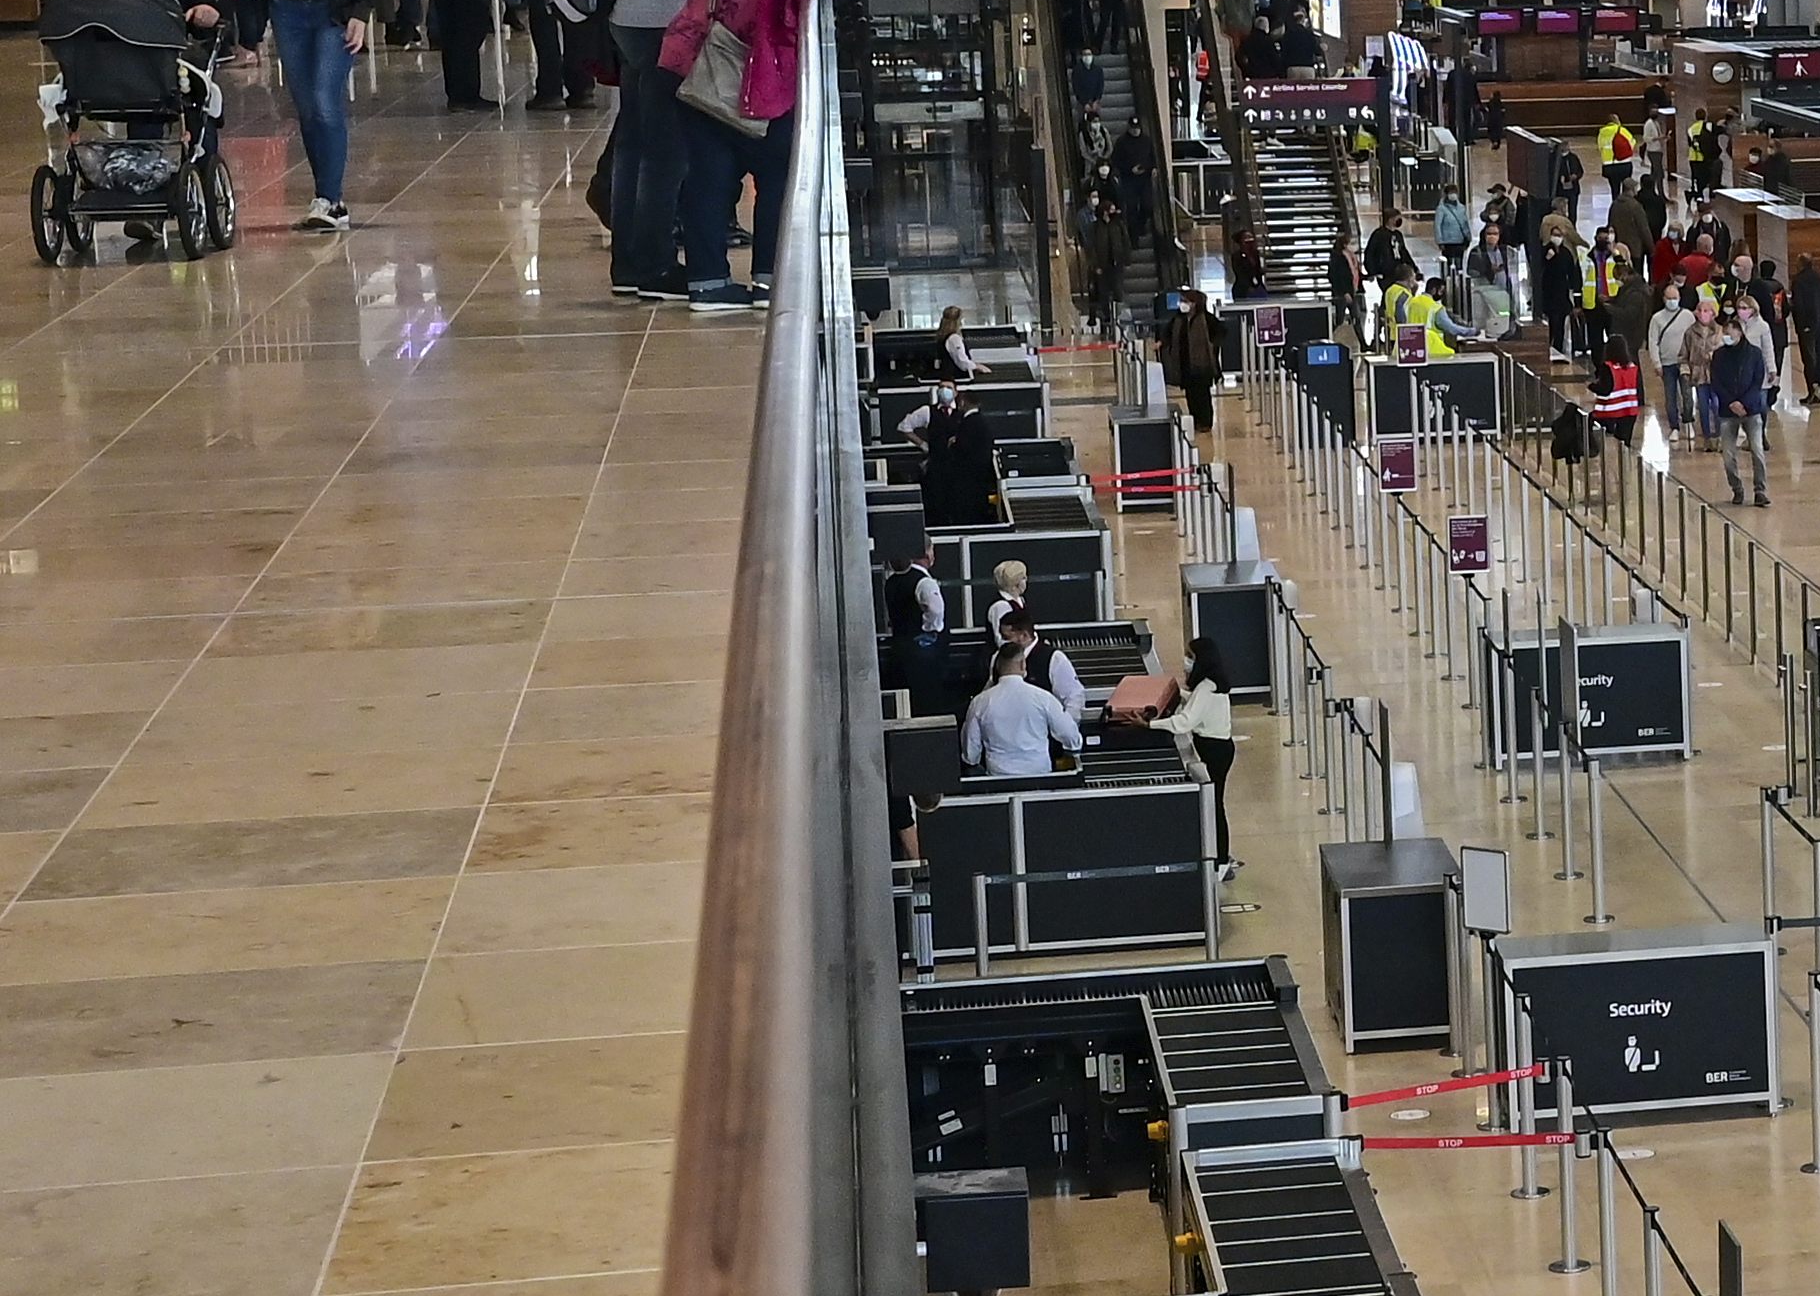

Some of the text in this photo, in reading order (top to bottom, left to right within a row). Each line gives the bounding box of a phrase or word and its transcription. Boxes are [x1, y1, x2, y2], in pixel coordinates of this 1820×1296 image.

[1579, 675, 1614, 688] curity
[1609, 999, 1672, 1019] Security
[1510, 1067, 1533, 1079] STOP
[1706, 1071, 1728, 1083] BER
[1416, 1084, 1439, 1096] STOP
[1438, 1139, 1463, 1148] STOP
[1546, 1134, 1570, 1144] STOP
